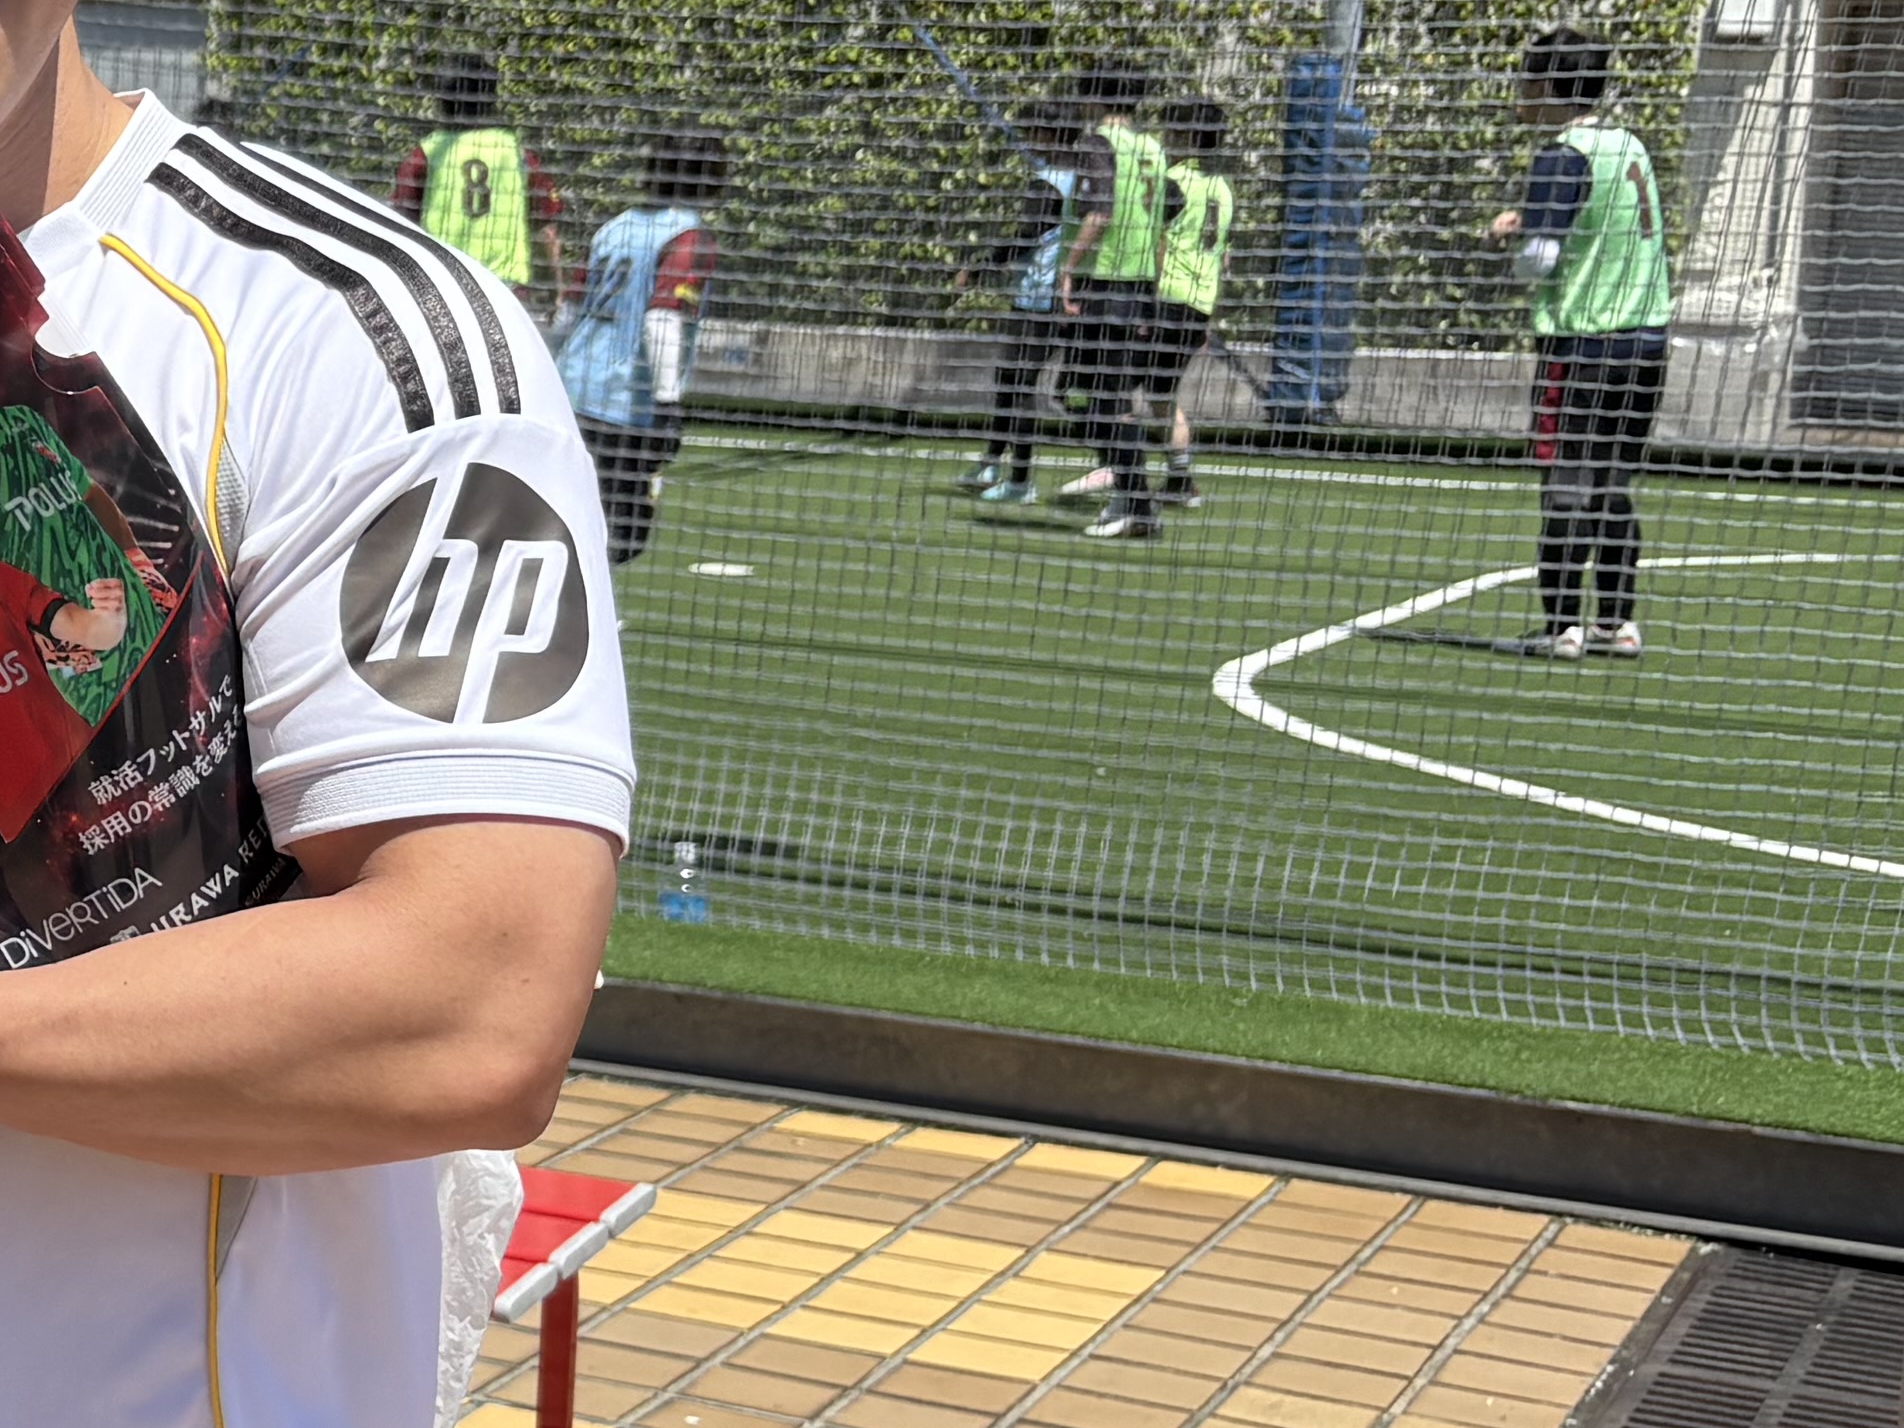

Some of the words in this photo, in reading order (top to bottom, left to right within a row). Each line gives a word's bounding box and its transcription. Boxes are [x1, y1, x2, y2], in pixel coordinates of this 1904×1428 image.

[461, 158, 491, 220] 8
[365, 461, 569, 724] hp
[88, 674, 233, 805] 就活フットサルで
